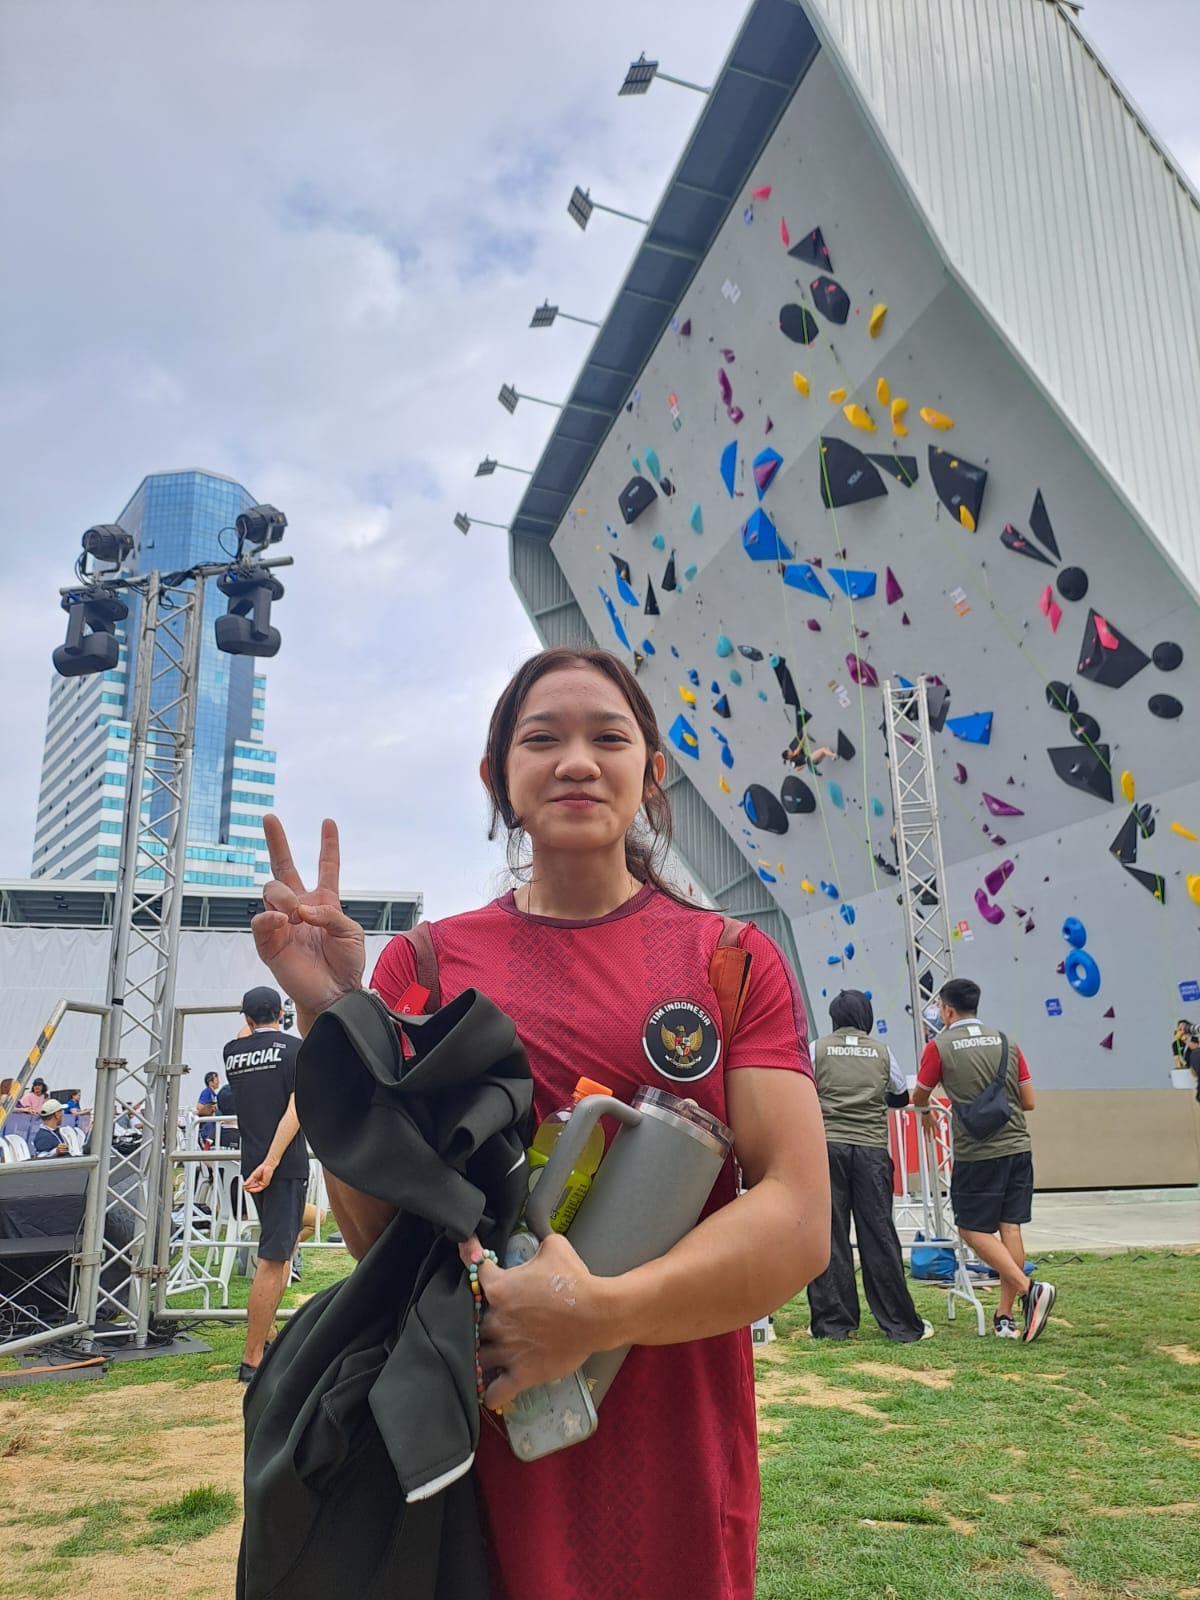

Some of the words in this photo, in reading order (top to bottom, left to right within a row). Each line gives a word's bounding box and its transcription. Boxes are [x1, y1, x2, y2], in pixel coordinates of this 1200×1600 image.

[649, 1008, 665, 1025] TIM
[664, 1002, 711, 1026] INDONESIA
[827, 1046, 879, 1058] INDONESIA
[952, 1036, 1002, 1050] INDONESIA
[226, 1047, 282, 1071] OFFICIAL
